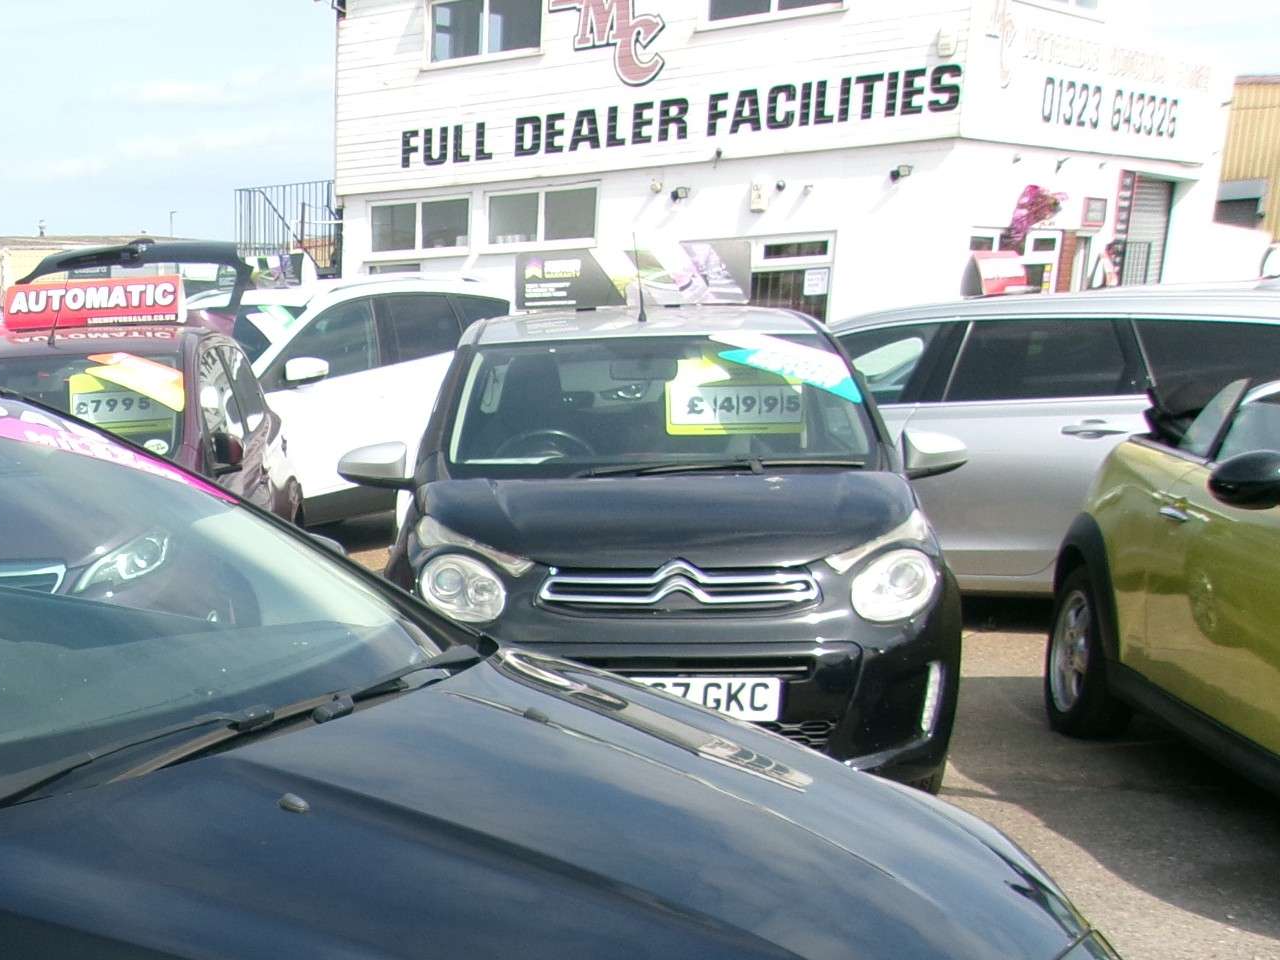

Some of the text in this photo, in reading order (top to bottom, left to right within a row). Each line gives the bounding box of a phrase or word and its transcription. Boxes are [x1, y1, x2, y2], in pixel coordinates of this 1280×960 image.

[401, 64, 962, 169] FULL DEALER FACILITIES
[1042, 77, 1178, 138] 01323 643326
[9, 282, 177, 315] AUTOMATIC
[703, 682, 770, 712] GKC
